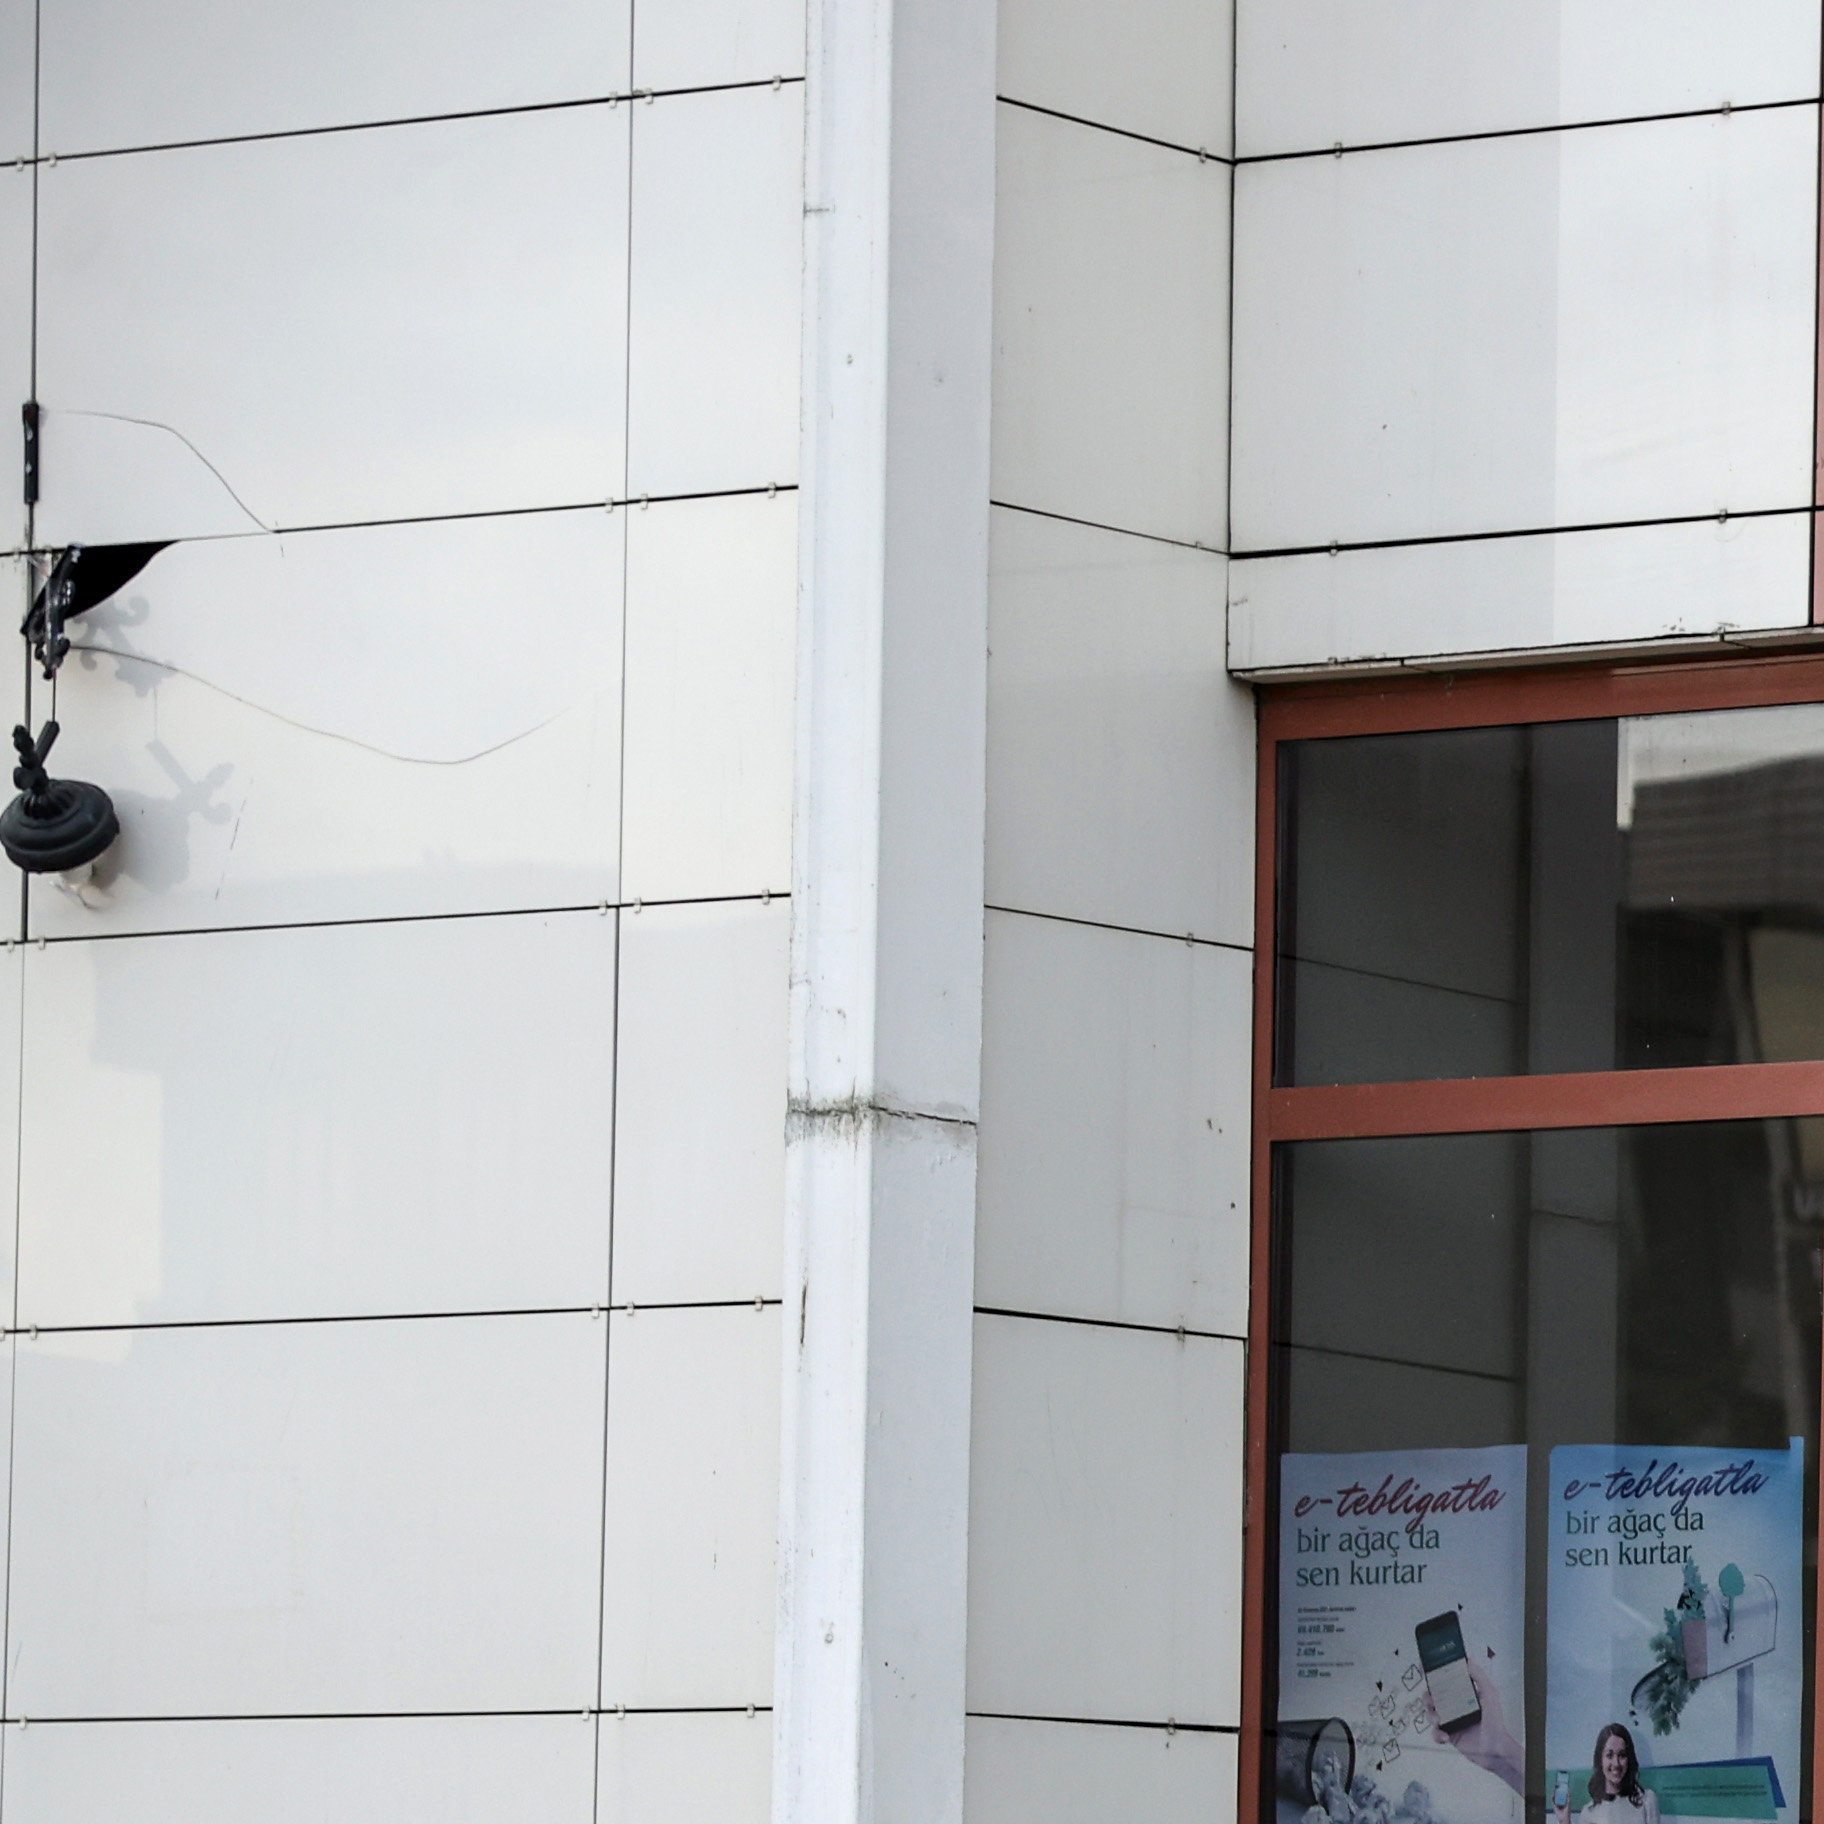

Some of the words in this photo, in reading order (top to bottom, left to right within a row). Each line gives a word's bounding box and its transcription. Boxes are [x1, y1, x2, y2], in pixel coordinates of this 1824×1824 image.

[1294, 1473, 1507, 1535] e-tebligatla
[1563, 1458, 1770, 1517] e-tebligatla
[1566, 1511, 1600, 1535] bir
[1607, 1508, 1665, 1541] ağaç
[1674, 1506, 1704, 1531] da
[1297, 1527, 1331, 1554] bir
[1339, 1525, 1400, 1559] ağaç
[1409, 1525, 1440, 1550] da
[1565, 1546, 1608, 1567] sen
[1618, 1541, 1693, 1566] kurtar
[1296, 1566, 1339, 1587] sen
[1350, 1560, 1428, 1586] kurtar
